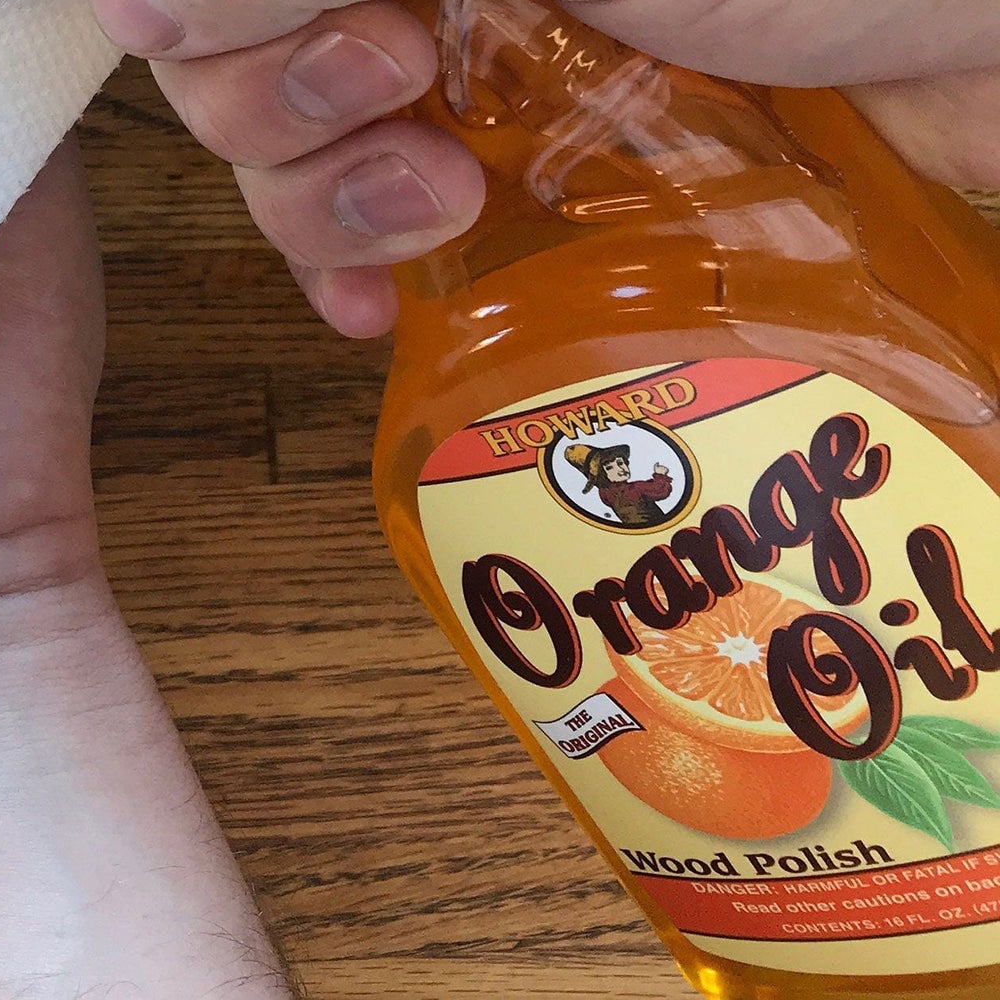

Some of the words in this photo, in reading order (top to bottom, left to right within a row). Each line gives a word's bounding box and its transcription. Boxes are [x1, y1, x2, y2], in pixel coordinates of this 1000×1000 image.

[480, 377, 697, 456] HOWARD
[462, 412, 892, 690] Orange
[766, 524, 1000, 762] Oil
[558, 713, 634, 752] ORIGINAL
[565, 709, 592, 732] THE
[619, 848, 741, 876] Wood
[743, 839, 895, 876] Polish
[691, 882, 779, 895] DANGER:
[783, 876, 870, 895] HARMFUL
[872, 872, 901, 886] OR
[902, 862, 962, 882] FATAL
[962, 857, 980, 870] IF
[732, 901, 783, 914] Read
[786, 901, 837, 914] other
[842, 889, 931, 910] cautions
[935, 884, 963, 898] on
[782, 918, 881, 934] CONTENTS:
[885, 916, 905, 928] 16
[906, 912, 936, 925] FL.
[938, 906, 972, 921] OZ.
